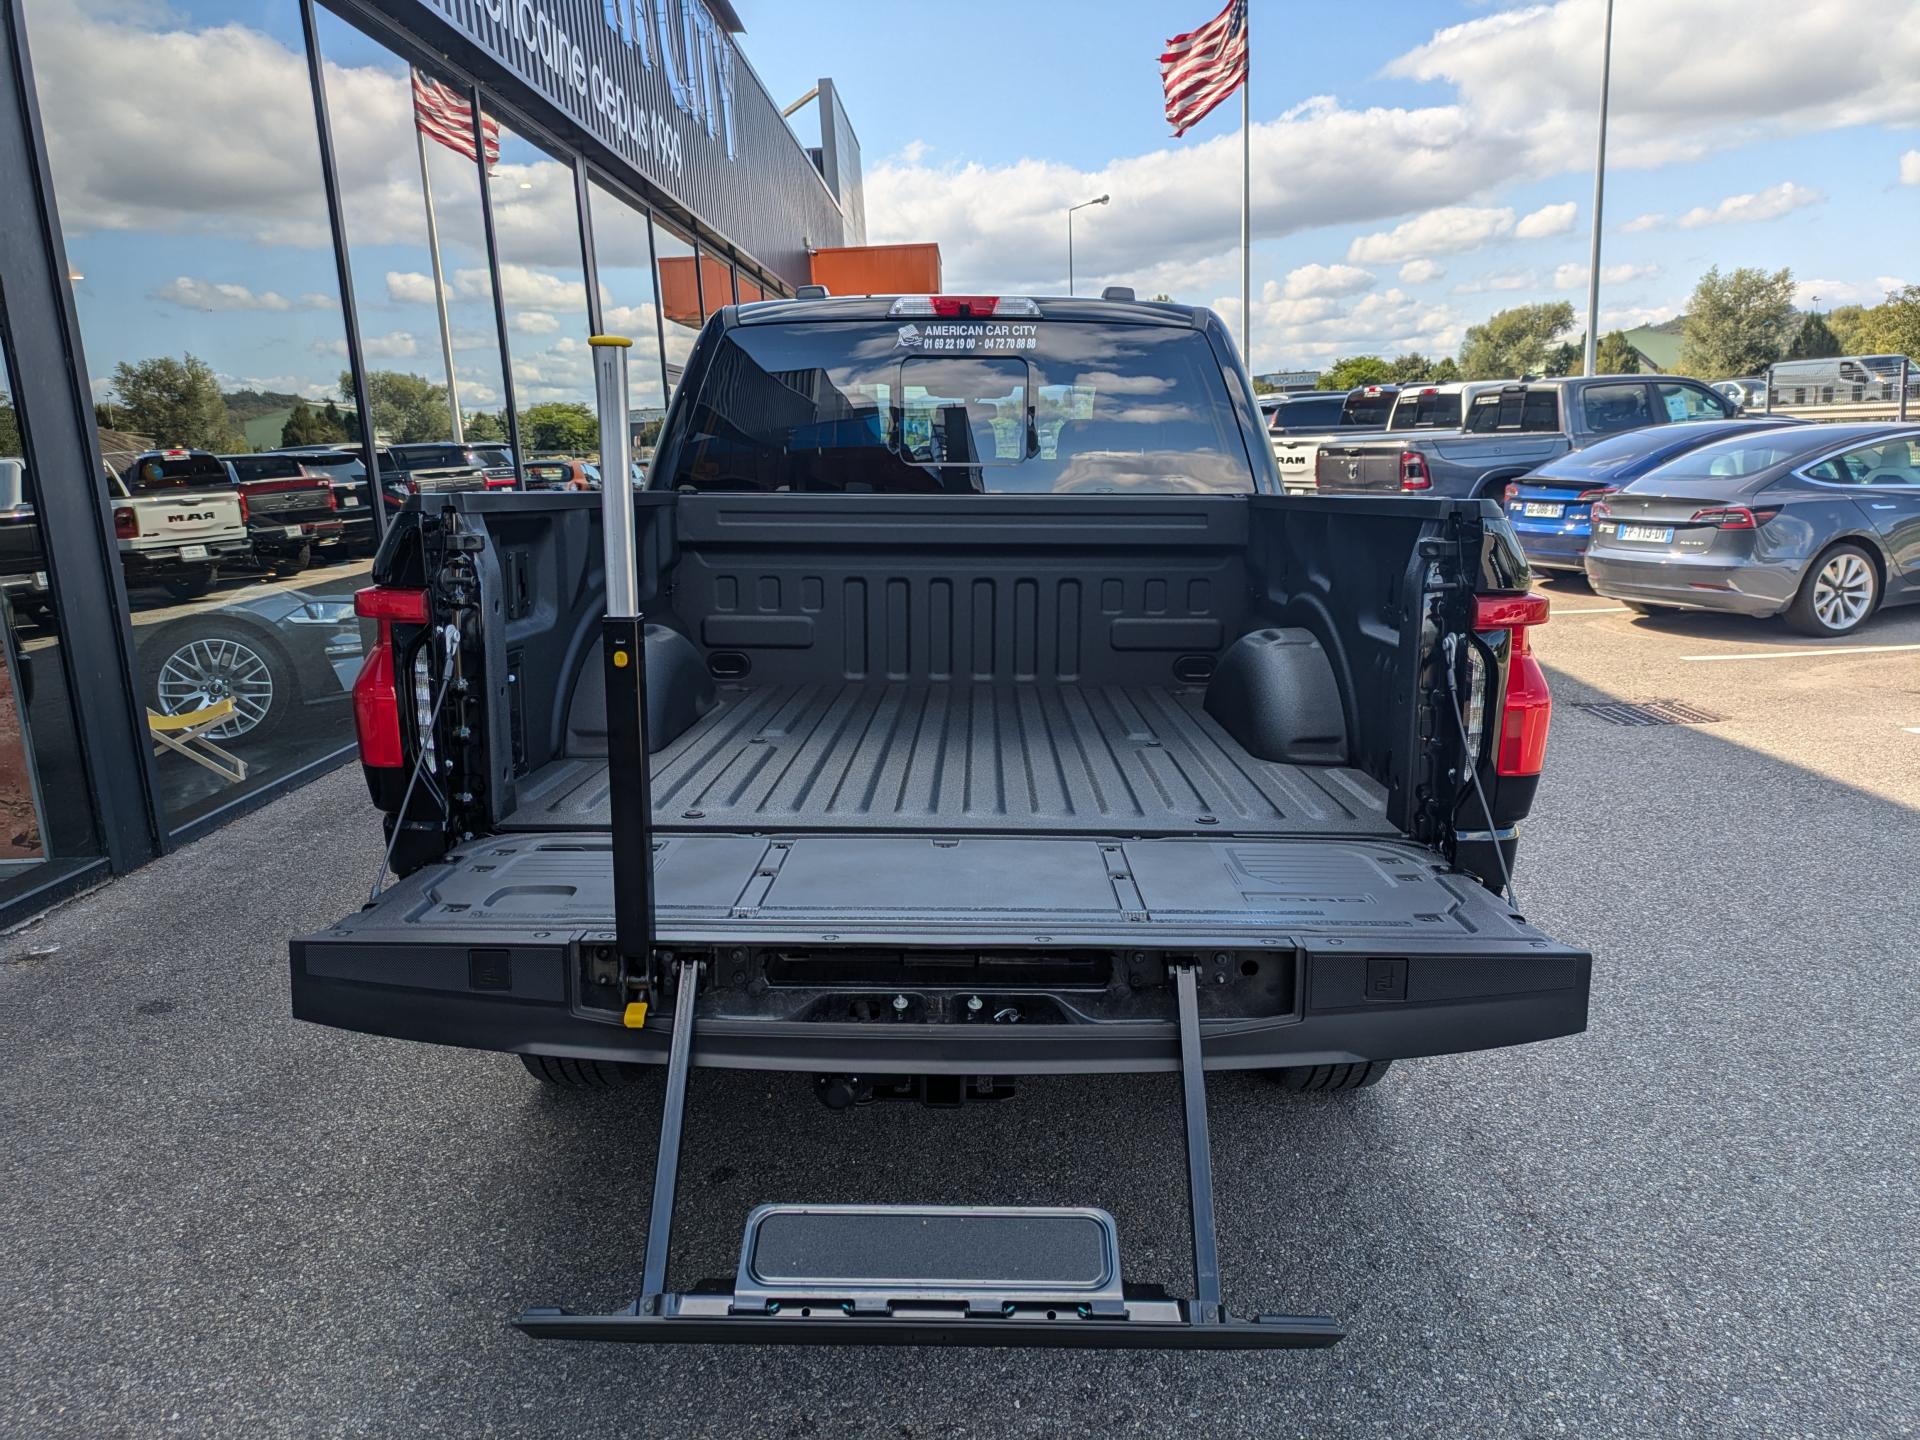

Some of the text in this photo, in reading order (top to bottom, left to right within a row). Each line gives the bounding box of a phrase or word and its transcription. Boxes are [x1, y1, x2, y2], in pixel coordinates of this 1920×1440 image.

[475, 0, 587, 96] icaine
[592, 56, 648, 151] depuis
[651, 109, 681, 178] 1999
[924, 325, 1037, 336] AMERICAN CAR CITY
[924, 338, 933, 349] 01
[934, 338, 944, 349] 69
[945, 338, 955, 349] 22
[956, 338, 964, 349] 19
[966, 338, 976, 349] 00
[984, 338, 994, 349] 04
[995, 338, 1005, 349] 72
[1006, 338, 1015, 349] 70
[1276, 456, 1305, 464] RAM
